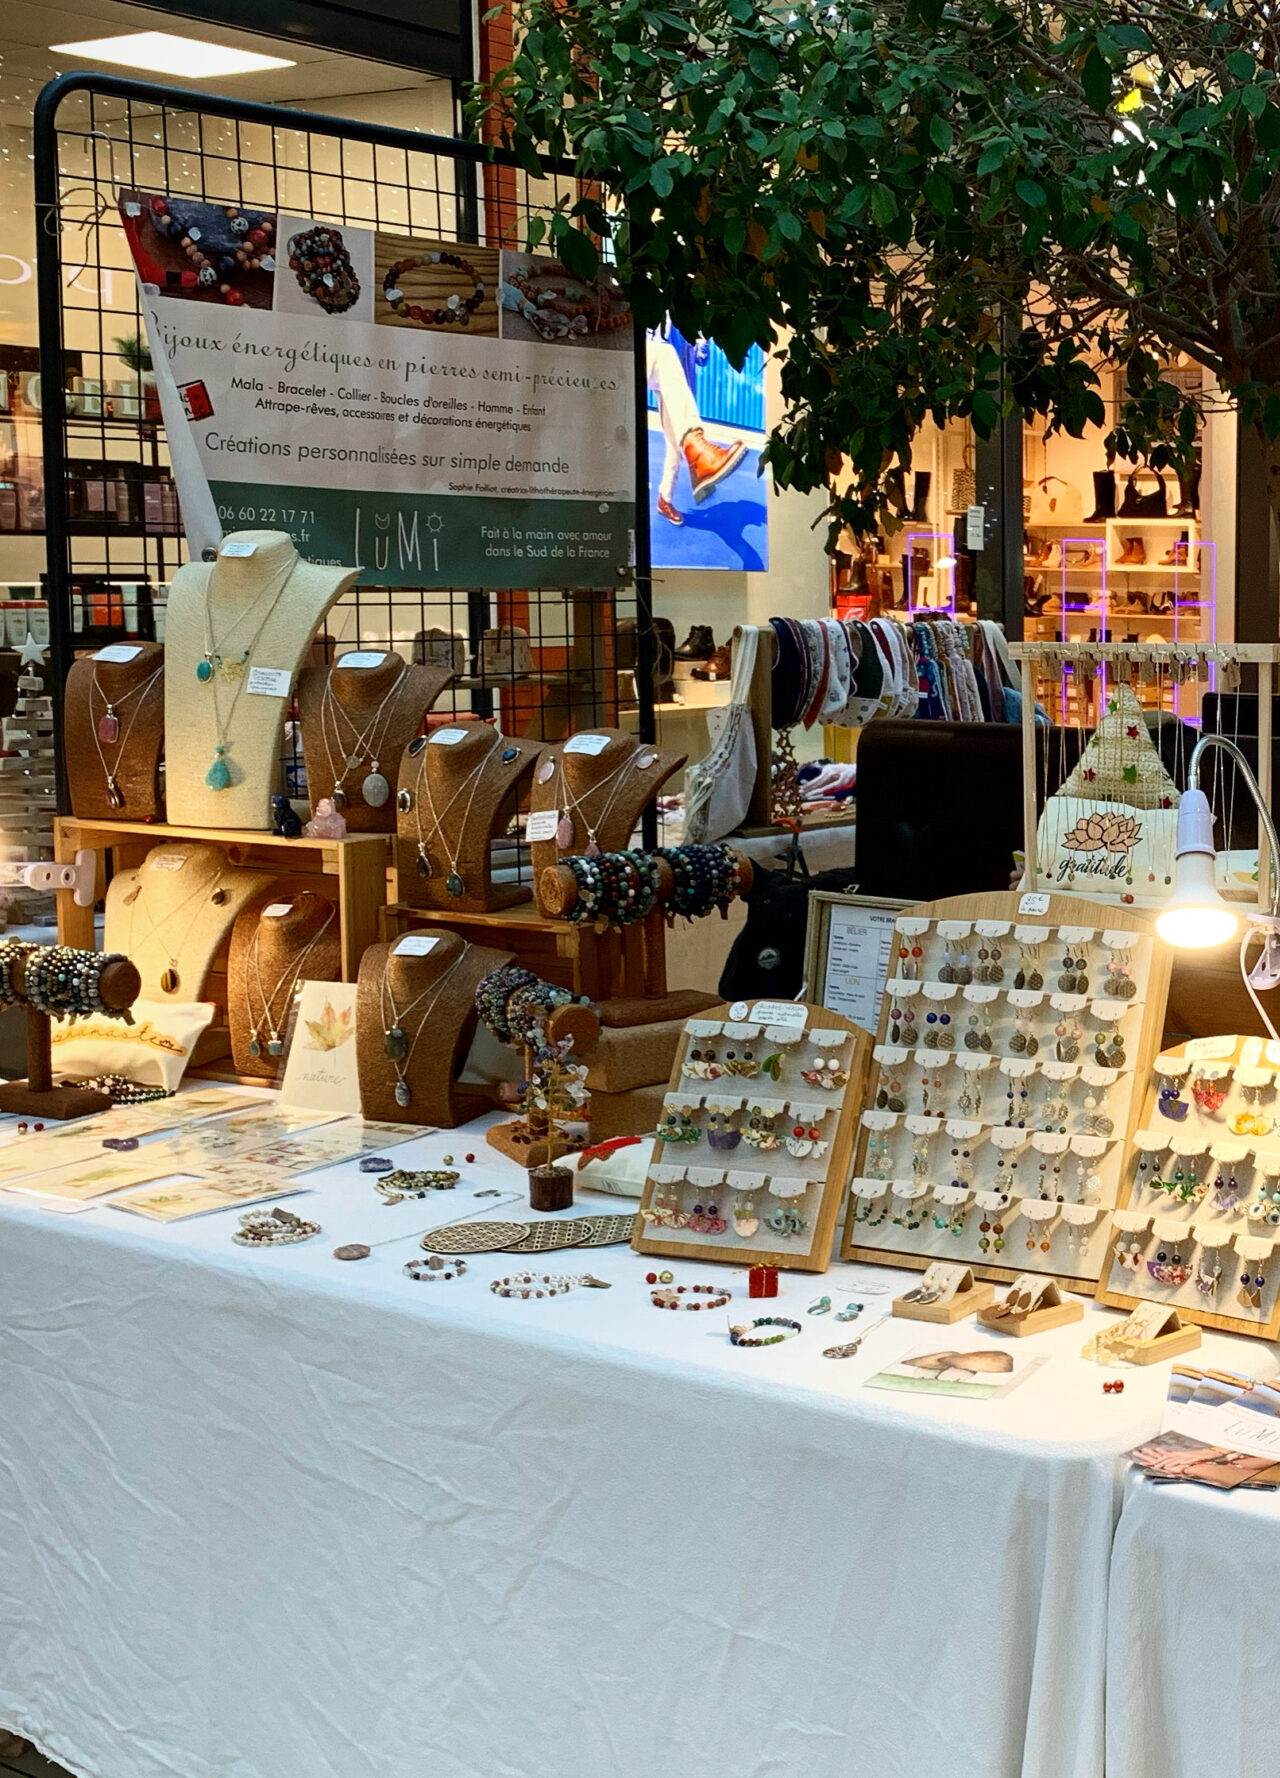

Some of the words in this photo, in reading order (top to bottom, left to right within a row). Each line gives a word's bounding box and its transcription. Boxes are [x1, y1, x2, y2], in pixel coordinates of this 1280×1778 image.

[151, 311, 226, 359] ijoux
[232, 332, 372, 373] énergétiques
[378, 357, 399, 371] en
[405, 356, 476, 382] pierres
[231, 377, 263, 391] Mala
[277, 382, 326, 398] Bracelet
[337, 388, 371, 402] Collier
[380, 392, 419, 408] Boucles
[423, 396, 468, 412] d'oreilles
[477, 401, 514, 415] Homme
[522, 404, 546, 416] Enfant
[255, 398, 339, 418] Attrape-rêves,
[342, 408, 395, 422] accessoires
[398, 412, 409, 423] et
[413, 412, 473, 428] décorations
[475, 417, 532, 433] énergétiques
[205, 431, 291, 457] Créations
[298, 444, 416, 466] personnalisées
[422, 454, 446, 468] sur
[450, 452, 501, 474] simple
[505, 455, 570, 474] demande
[448, 482, 474, 493] Sophie
[219, 505, 234, 520] 06
[238, 507, 256, 521] 60
[259, 508, 277, 522] 22
[282, 510, 295, 523] 17
[300, 511, 315, 524] 71
[481, 526, 500, 539] Fait
[503, 527, 509, 539] à
[512, 526, 522, 539] la
[526, 528, 553, 540] main
[556, 531, 580, 541] avec
[582, 532, 612, 542] amour
[485, 544, 511, 557] dans
[514, 544, 523, 557] le
[526, 544, 547, 558] Sud
[551, 545, 564, 558] de
[566, 545, 576, 558] la
[578, 545, 610, 558] France
